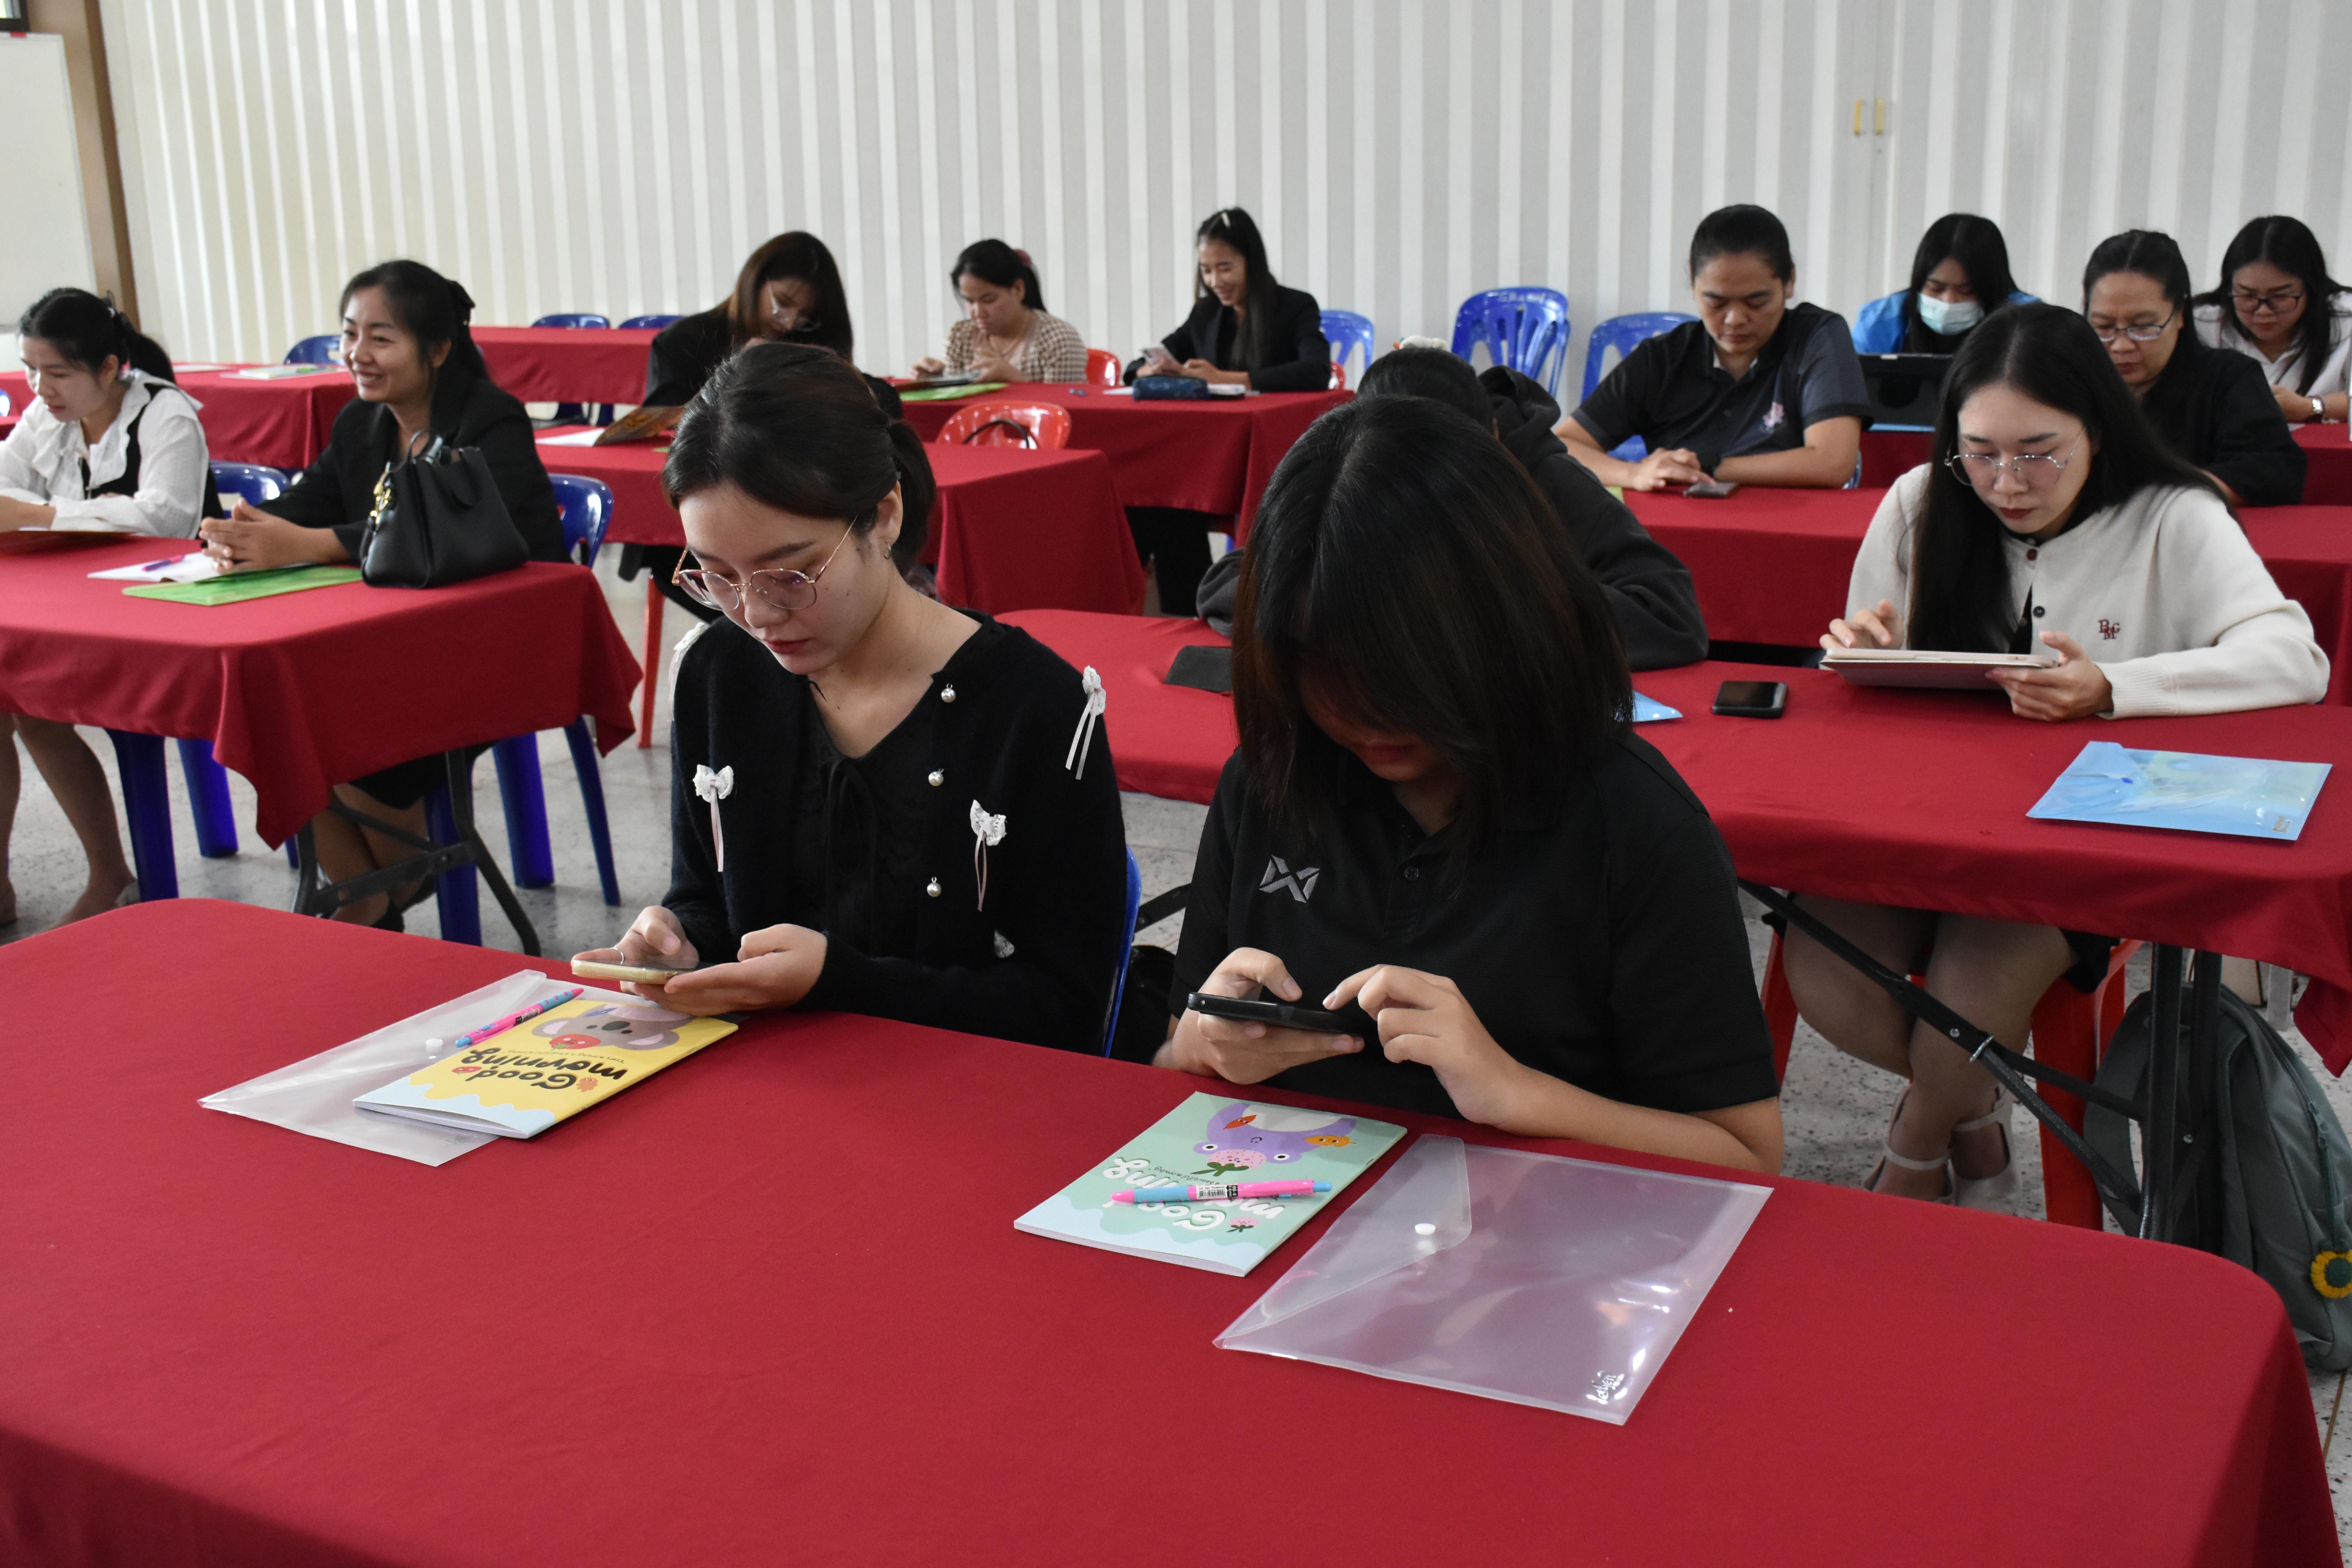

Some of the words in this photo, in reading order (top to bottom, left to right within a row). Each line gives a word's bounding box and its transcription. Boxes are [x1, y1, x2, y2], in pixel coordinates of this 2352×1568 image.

[461, 1047, 628, 1080] morning
[465, 1069, 577, 1089] Good
[1180, 1175, 1215, 1185] beautiful
[1102, 1199, 1227, 1230] Goo
